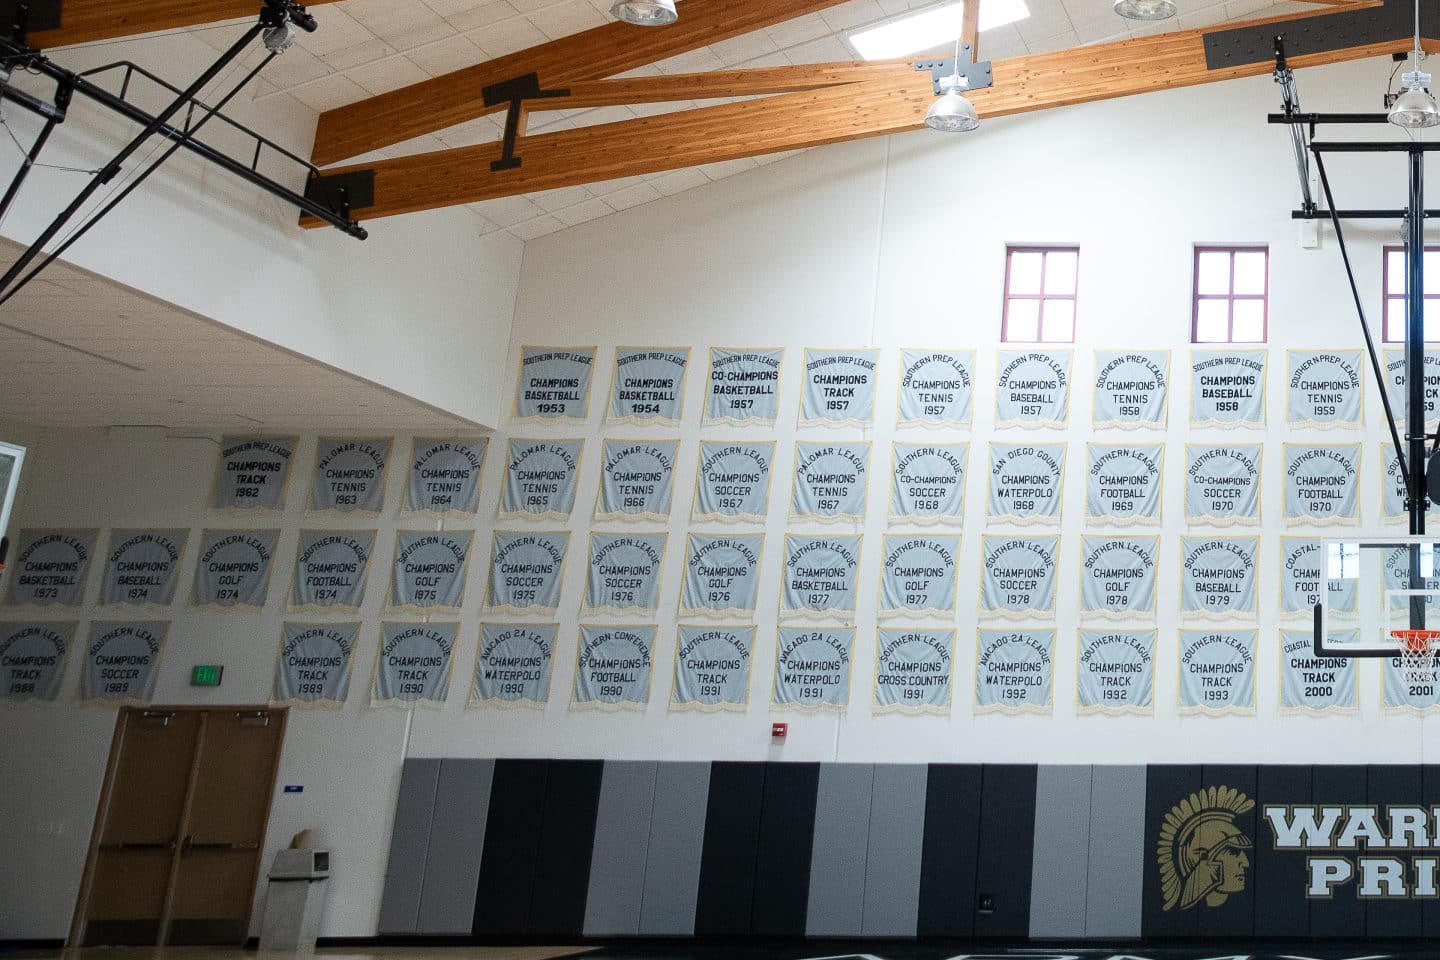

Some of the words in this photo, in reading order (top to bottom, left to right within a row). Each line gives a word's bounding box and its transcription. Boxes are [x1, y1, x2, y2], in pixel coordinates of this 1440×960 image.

[522, 353, 552, 366] SOUTHERN
[553, 352, 570, 360] PREP
[570, 354, 594, 366] LEAGUE
[616, 353, 647, 367] SOUTHERN
[648, 352, 664, 360] PREP
[664, 354, 687, 368] LEAGUE
[1192, 358, 1223, 373] SOUTHERN
[1224, 357, 1241, 365] PREP
[1241, 359, 1264, 372] LEAGUE
[711, 371, 778, 381] CO-CHAMPIONS
[1200, 376, 1255, 385] CHAMPIONS
[530, 378, 579, 388] CHAMPIONS
[625, 378, 674, 388] CHAMPIONS
[524, 390, 580, 400] BASKETBALL
[713, 385, 774, 395] BASKETBALL
[1202, 389, 1253, 398] BASEBALL
[619, 390, 675, 401] BASKETBALL
[537, 404, 565, 413] 1953
[632, 404, 660, 414] 1954
[730, 400, 753, 409] 1957
[1216, 402, 1238, 411] 1958
[508, 444, 546, 471] PALOMAR
[549, 445, 576, 472] LEAGUE
[227, 461, 281, 472] CHAMPIONS
[326, 469, 375, 479] CHAMPIONS
[517, 470, 566, 480] CHAMPIONS
[237, 475, 267, 484] TRACK
[1001, 475, 1050, 484] CHAMPIONS
[1099, 475, 1148, 485] CHAMPIONS
[331, 482, 366, 492] TENNIS
[522, 483, 558, 493] TENNIS
[235, 488, 259, 497] 1962
[998, 488, 1053, 498] WATERPOLO
[1100, 488, 1146, 498] FOOTBALL
[335, 495, 357, 505] 1963
[527, 496, 548, 505] 1965
[1013, 501, 1034, 510] 1968
[1112, 501, 1133, 511] 1969
[25, 562, 78, 572] CHAMPIONS
[117, 562, 169, 572] CHAMPIONS
[501, 564, 553, 574] CHAMPIONS
[599, 565, 651, 576] CHAMPIONS
[796, 567, 845, 577] CHAMPIONS
[19, 575, 76, 585] BASKETBALL
[117, 576, 161, 585] BASEBALL
[506, 577, 543, 587] SOCCER
[605, 578, 643, 588] SOCCER
[792, 580, 848, 591] BASKETBALL
[33, 588, 58, 598] 1973
[127, 589, 148, 599] 1974
[513, 590, 535, 600] 1975
[611, 592, 633, 601] 1976
[808, 594, 829, 604] 1977
[778, 634, 808, 666] AVACADO
[811, 632, 822, 641] 2A
[826, 635, 849, 666] LEAGUE
[289, 656, 341, 667] CHAMPIONS
[787, 660, 840, 671] CHAMPIONS
[1291, 658, 1347, 669] CHAMPIONS
[888, 662, 941, 672] CHAMPIONS
[1190, 663, 1244, 673] CHAMPIONS
[298, 670, 329, 680] TRACK
[784, 673, 840, 685] WATERPOLO
[878, 674, 907, 686] CROSS
[909, 675, 949, 686] COUNTRY
[1302, 672, 1335, 683] TRACK
[1202, 677, 1232, 687] TRACK
[298, 684, 323, 694] 1989
[799, 688, 823, 698] 1991
[903, 689, 924, 699] 1991
[1305, 686, 1332, 697] 2000
[1205, 690, 1229, 701] 1993
